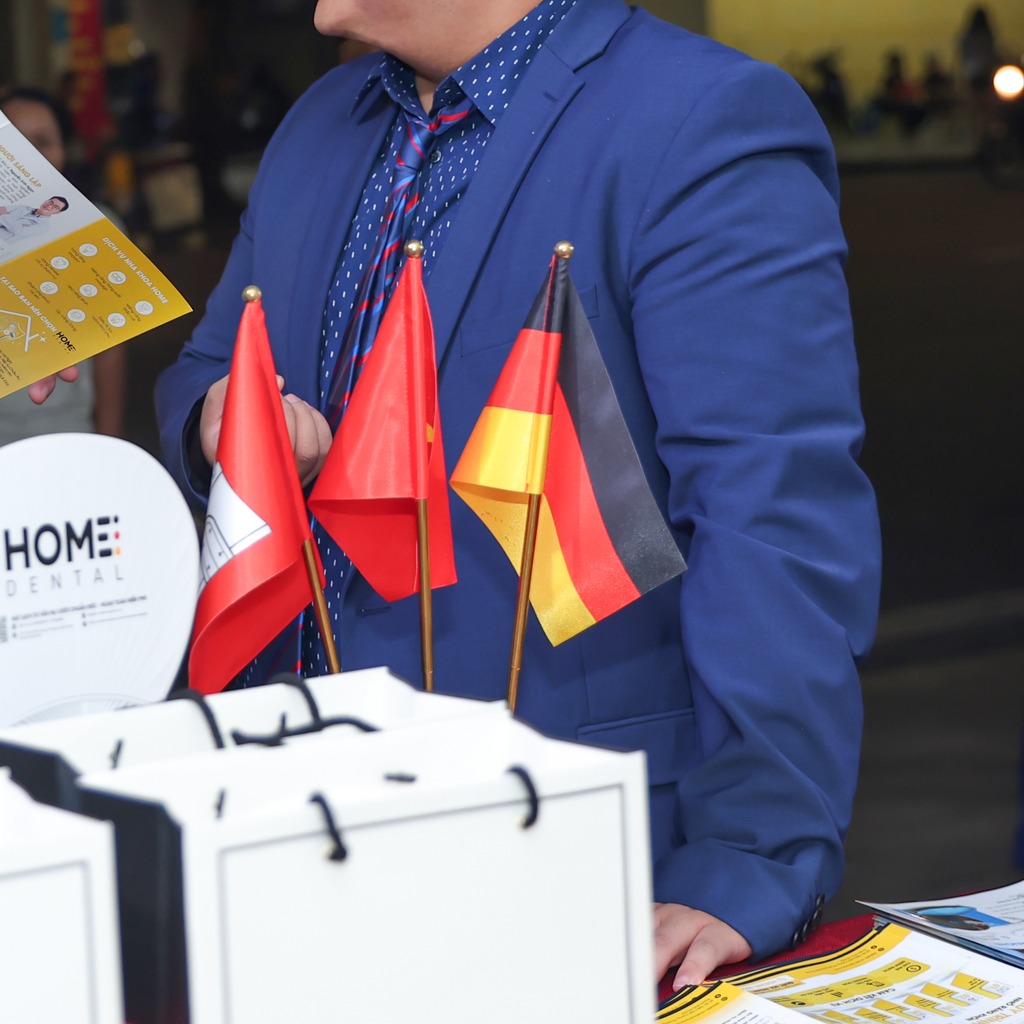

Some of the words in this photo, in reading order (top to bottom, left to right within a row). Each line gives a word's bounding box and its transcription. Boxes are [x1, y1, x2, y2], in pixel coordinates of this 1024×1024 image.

[56, 332, 76, 352] HOME
[3, 515, 123, 571] HOME
[6, 566, 125, 597] DENTAL
